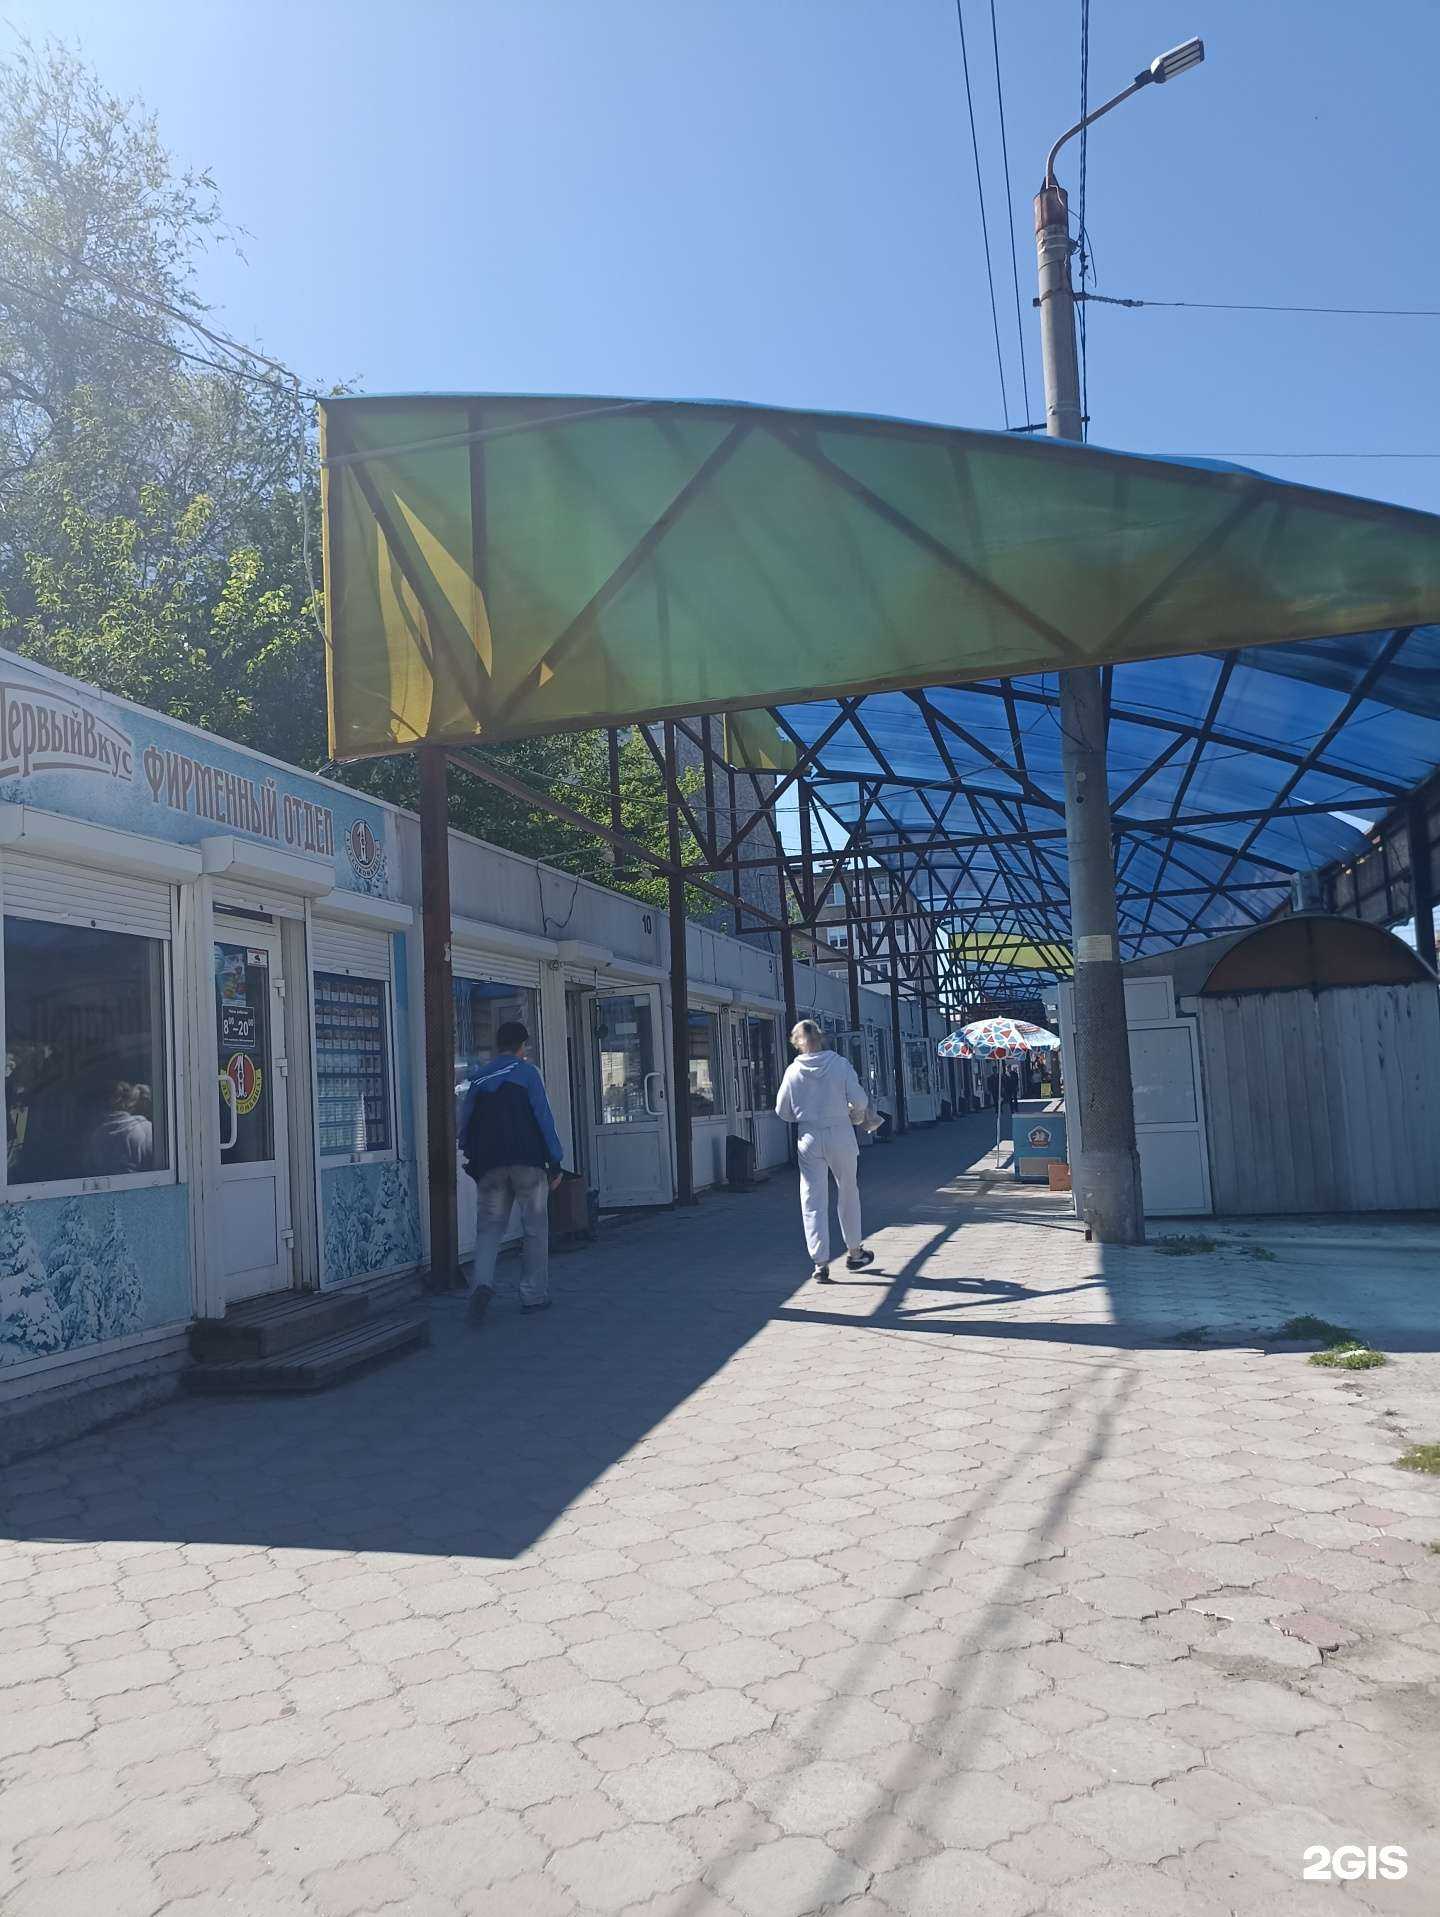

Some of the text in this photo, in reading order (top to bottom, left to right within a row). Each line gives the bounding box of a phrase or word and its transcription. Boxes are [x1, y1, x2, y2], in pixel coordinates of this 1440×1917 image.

[143, 745, 279, 841] ФИРМЕННЫЙ
[284, 792, 335, 857] ОТДЕЛ
[642, 914, 653, 935] 10
